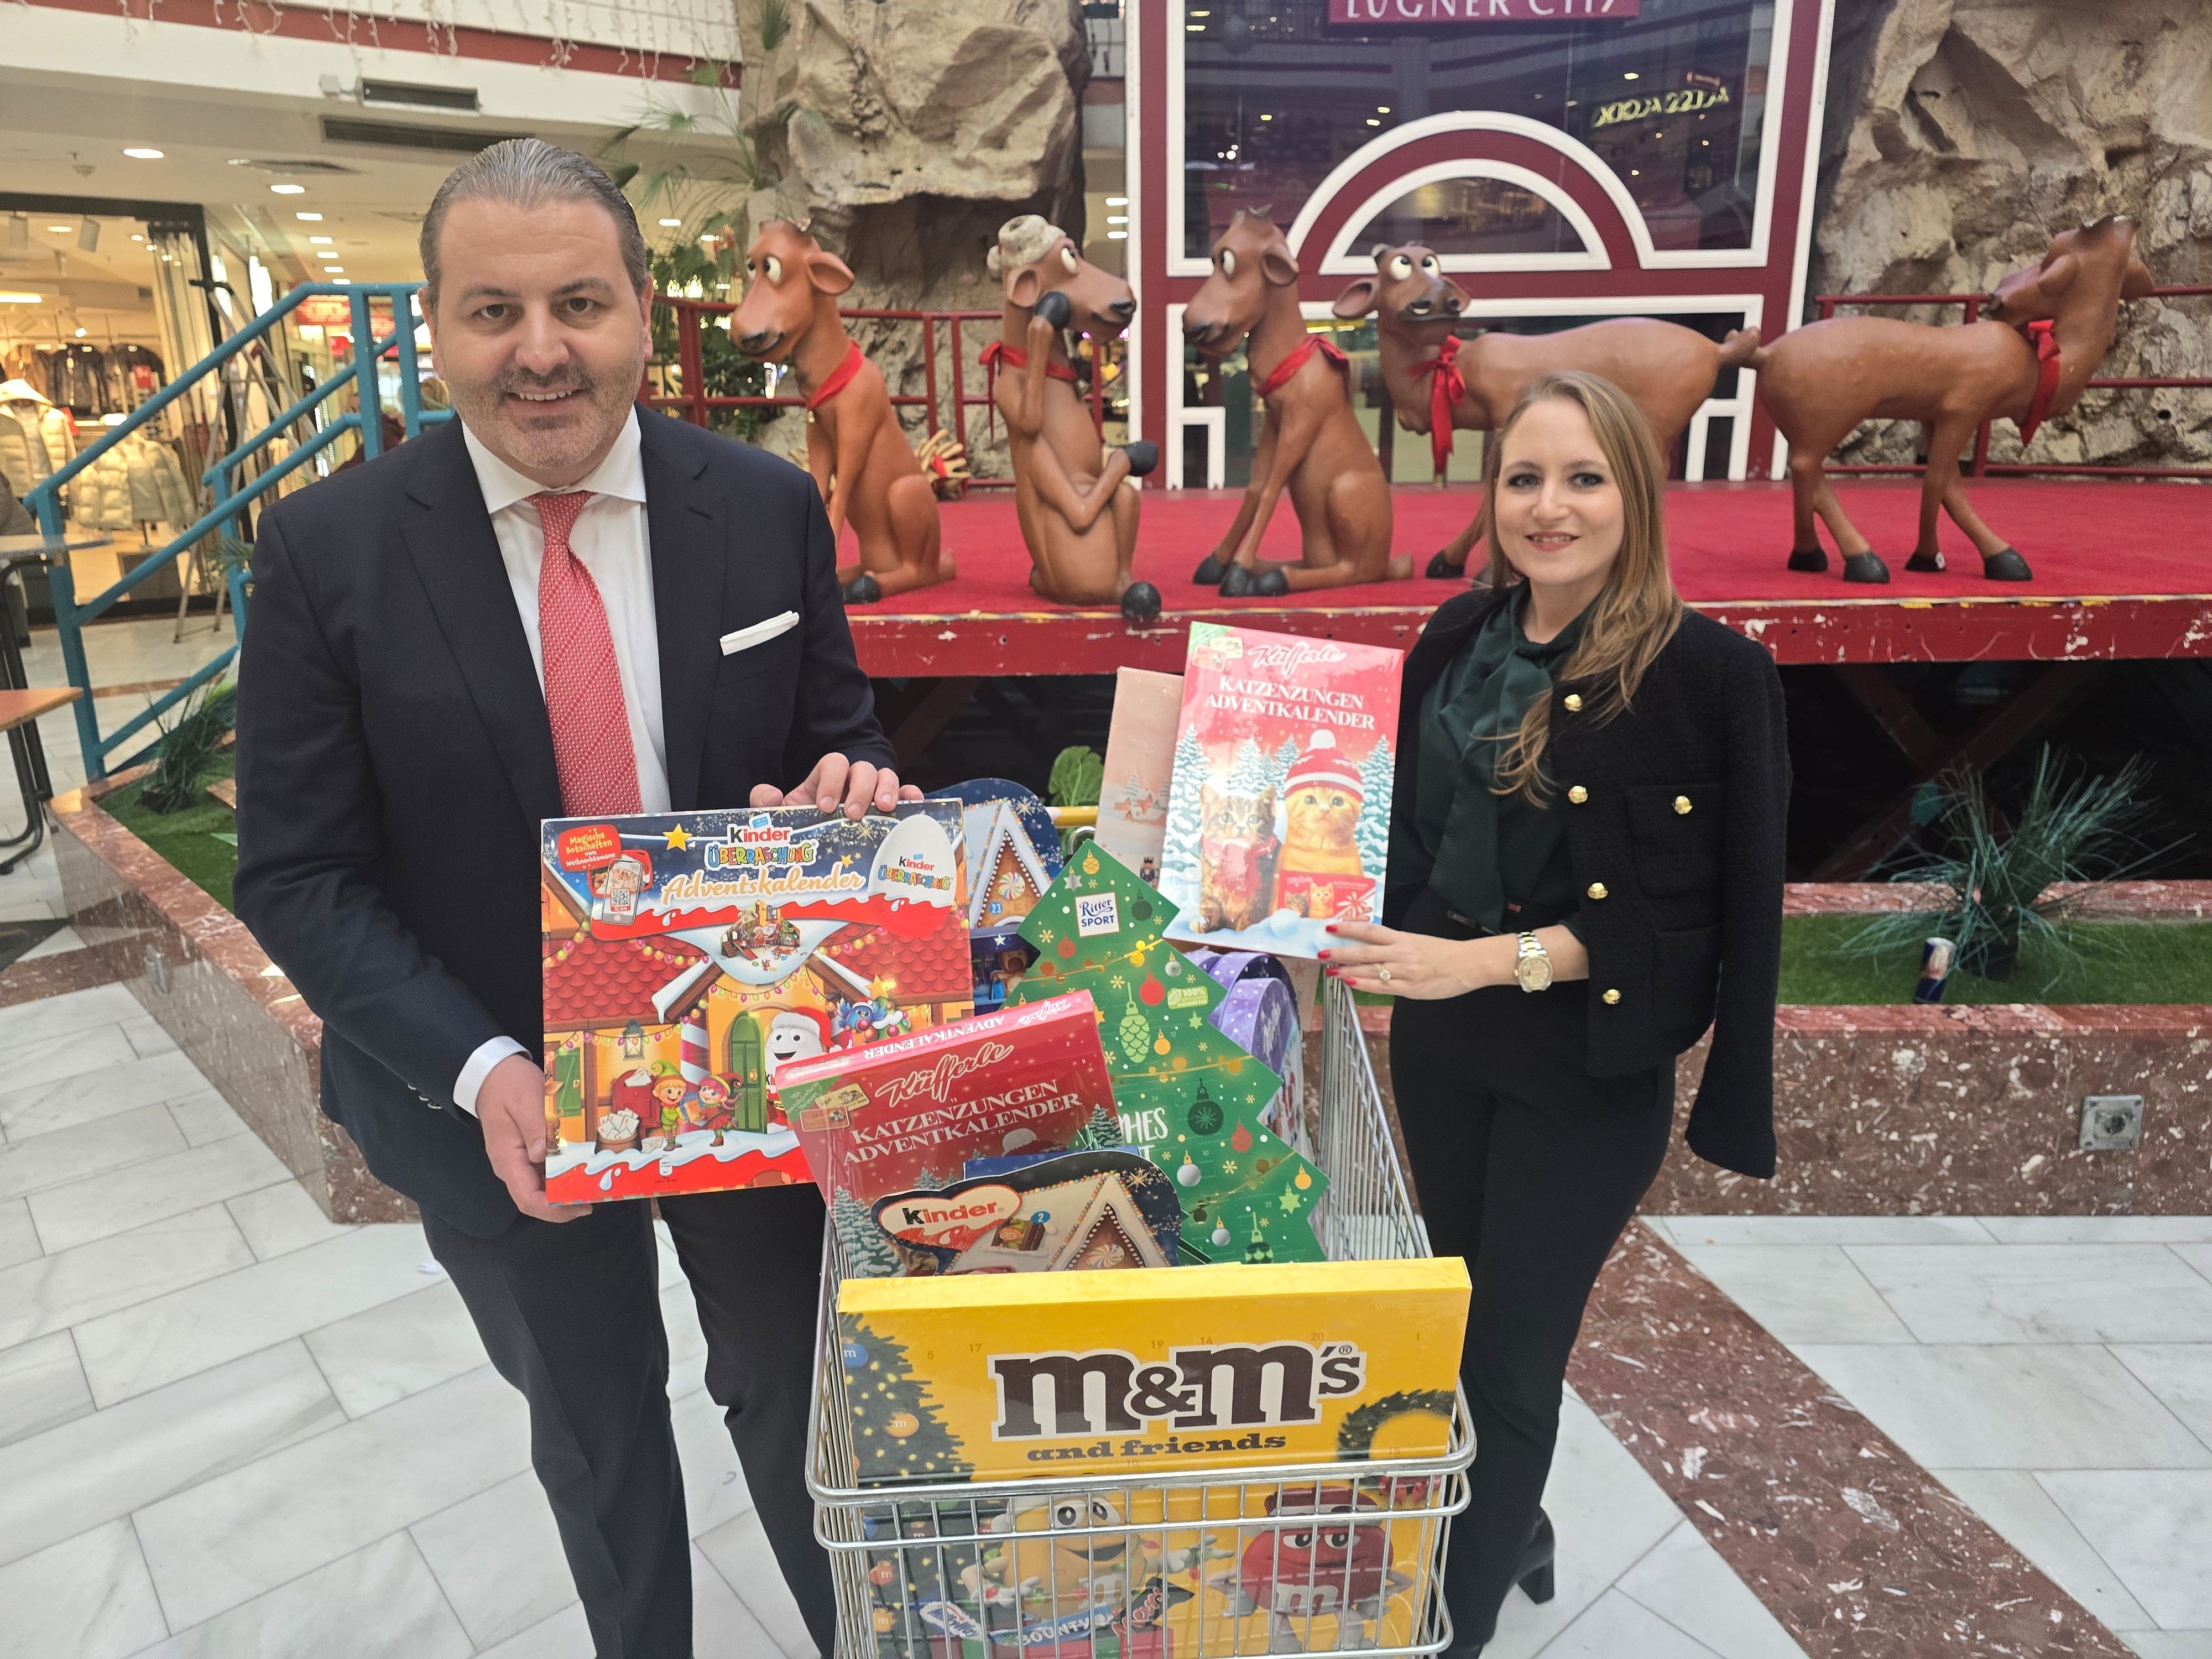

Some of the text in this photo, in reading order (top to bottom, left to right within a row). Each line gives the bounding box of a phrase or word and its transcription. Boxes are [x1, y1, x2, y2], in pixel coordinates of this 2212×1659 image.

[1219, 676, 1364, 709] KATZENZUNGEN
[1203, 693, 1375, 731] ADVENTKALENDER
[565, 839, 613, 855] Botschaften
[570, 831, 605, 846] Magische
[566, 853, 615, 867] Weihnachtsmann
[707, 842, 814, 867] ÜBERRASCHUNG
[663, 864, 863, 902] Adventskalender
[878, 864, 951, 890] ÜBERRASCHUNG
[1079, 900, 1113, 917] Ritter
[1082, 915, 1114, 927] SPORT
[1182, 987, 1206, 997] 100%
[863, 1015, 1004, 1060] ADVENTKALENDER
[851, 1079, 1058, 1145] KATZENZUNGEN
[843, 1093, 1083, 1166] ADVENTKALENDER
[1038, 1213, 1045, 1223] 2
[1311, 1332, 1324, 1342] 20
[969, 1343, 982, 1353] 17
[1027, 1432, 1286, 1462] and friends
